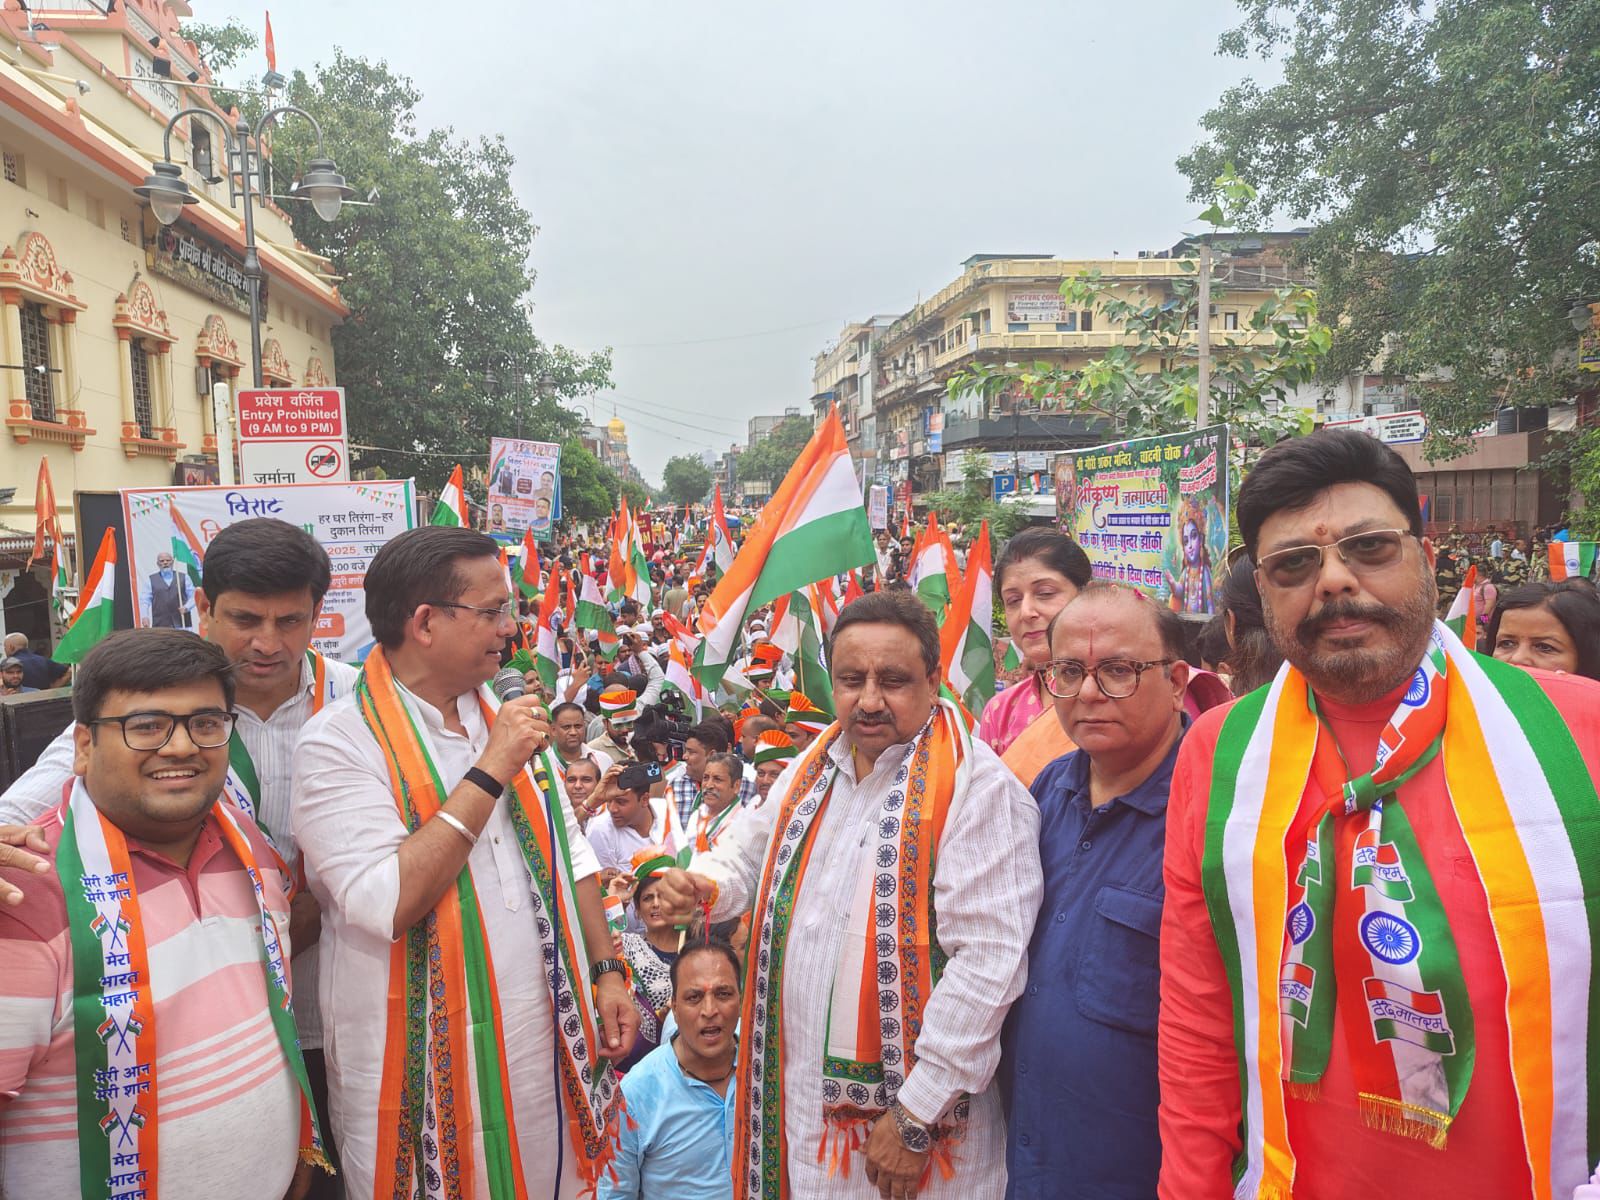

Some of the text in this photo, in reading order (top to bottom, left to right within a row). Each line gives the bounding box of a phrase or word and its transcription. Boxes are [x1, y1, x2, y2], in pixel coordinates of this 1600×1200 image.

[254, 392, 324, 407] प्रवेश वर्जित
[241, 409, 339, 422] Entry Prohibited
[249, 423, 334, 435] (9 AM to 9 PM)
[253, 469, 295, 485] जर्माना
[1001, 478, 1009, 490] P
[225, 492, 284, 517] विराट
[319, 513, 330, 525] हर
[333, 513, 347, 524] घर
[330, 524, 384, 539] दुकान तिरंगा
[82, 872, 128, 887] मेरी आन
[86, 888, 131, 903] मेरी शान
[105, 952, 130, 967] मेरा
[100, 971, 139, 988] भारत
[101, 991, 139, 1007] महान
[96, 1064, 151, 1082] मेरी आन
[96, 1081, 151, 1101] मेरी शान
[112, 1153, 141, 1167] मेरा
[107, 1170, 149, 1187] भारत
